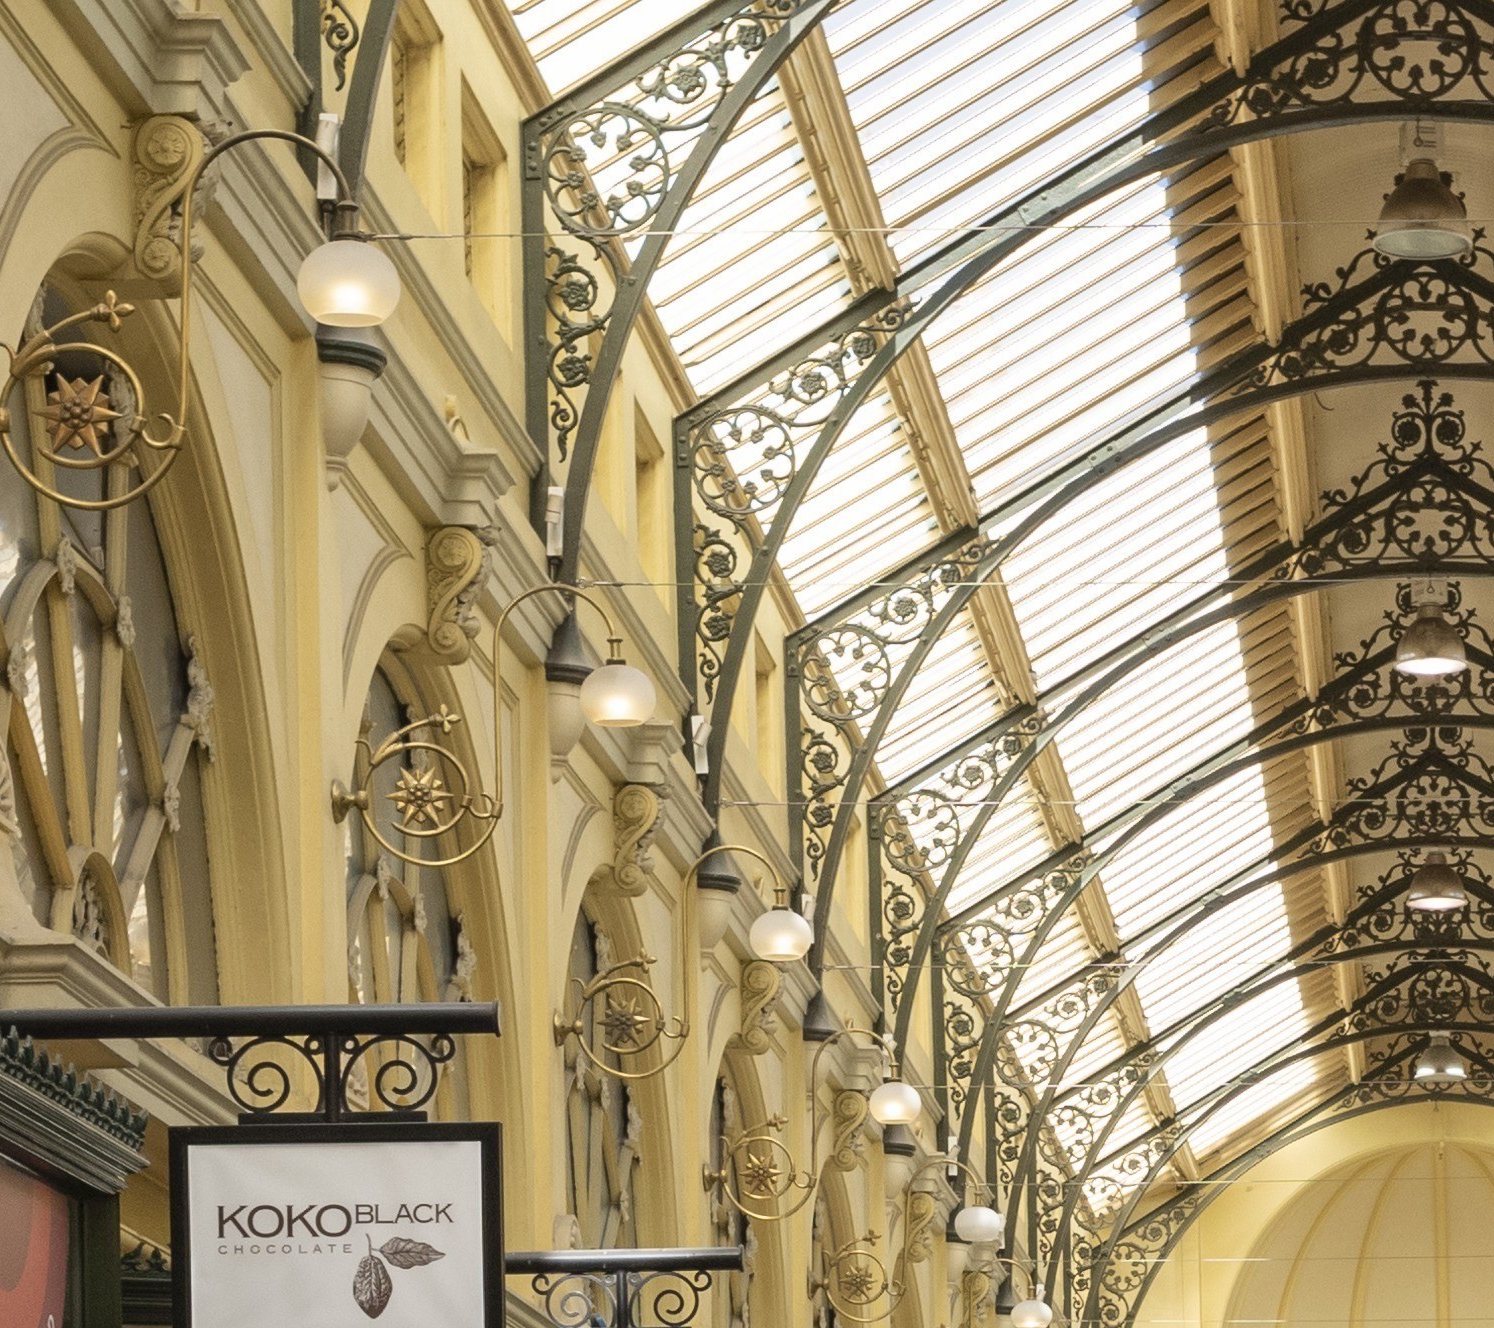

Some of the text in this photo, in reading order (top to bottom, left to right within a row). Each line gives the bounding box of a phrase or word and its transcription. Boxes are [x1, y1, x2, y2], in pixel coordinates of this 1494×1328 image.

[217, 1202, 454, 1240] KOKO BLACK
[217, 1244, 352, 1255] CHOCOLATE
